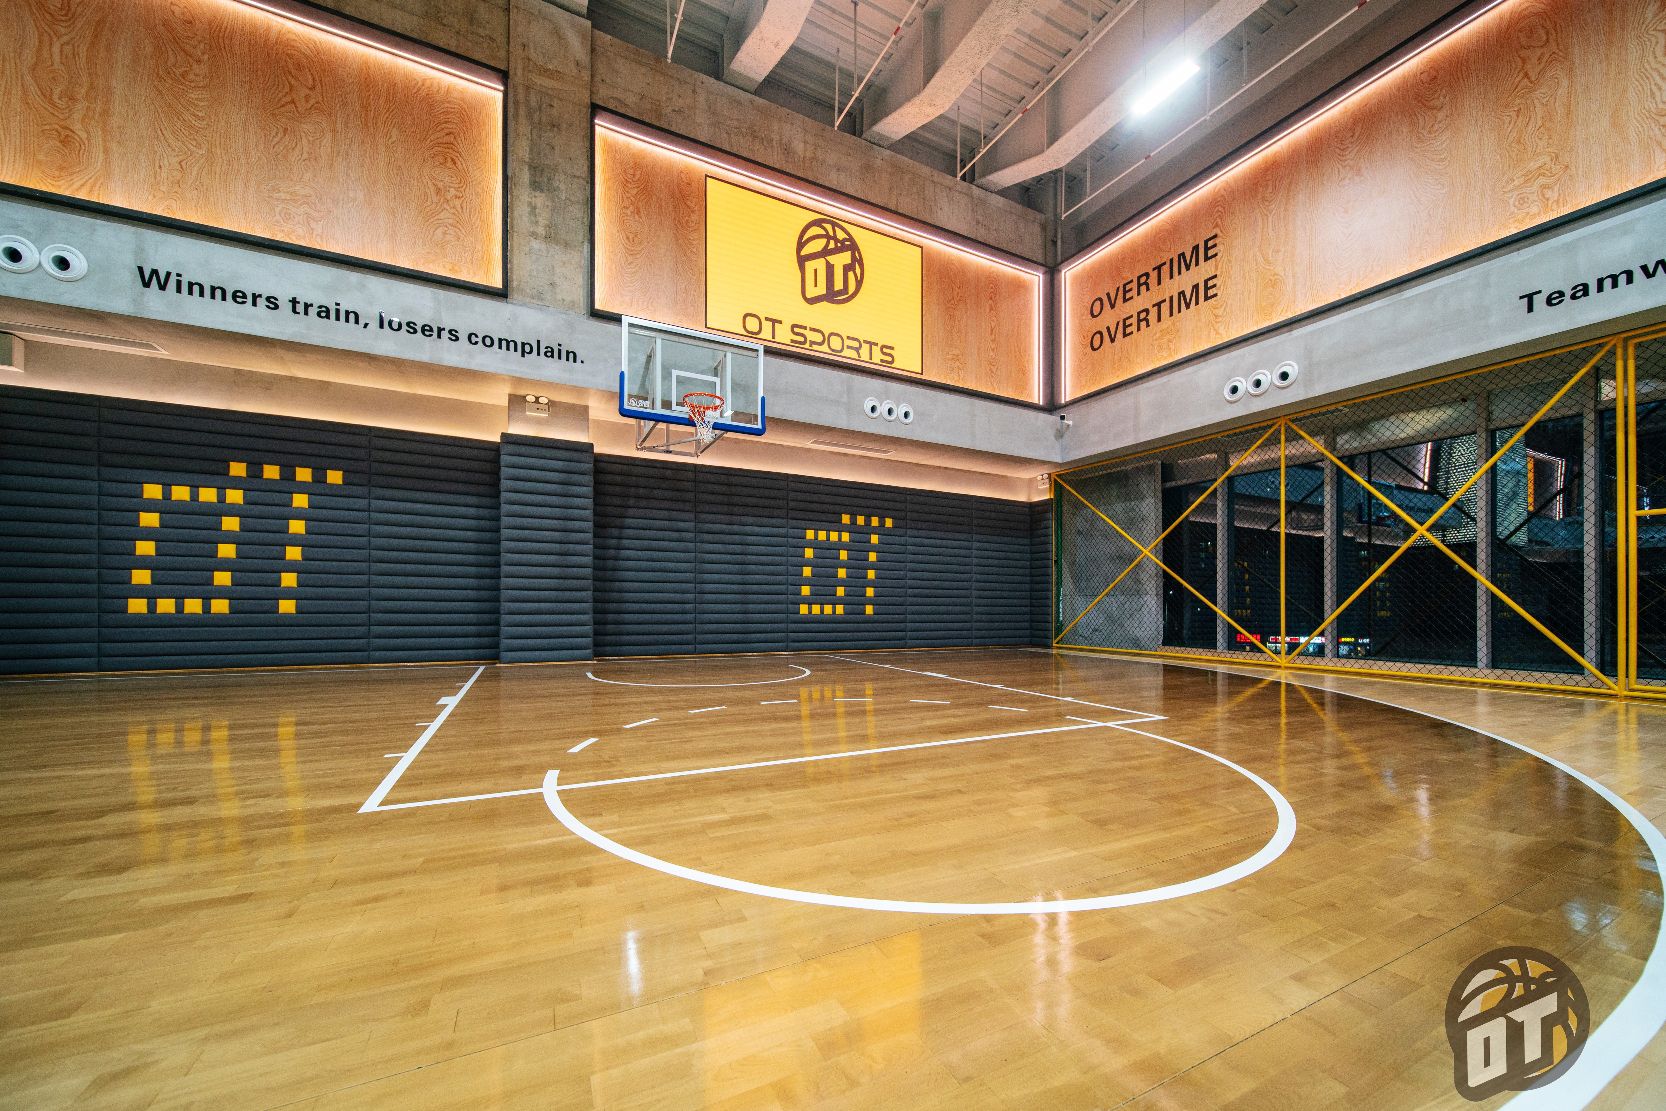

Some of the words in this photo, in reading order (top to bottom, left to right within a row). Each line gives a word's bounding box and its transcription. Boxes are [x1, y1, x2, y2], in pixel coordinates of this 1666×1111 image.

[136, 265, 280, 311] Winners
[288, 296, 371, 330] train,
[378, 310, 460, 343] losers
[467, 332, 586, 365] complain.
[803, 249, 853, 302] OT
[1089, 233, 1218, 319] OVERTIME
[1089, 273, 1218, 352] OVERTIME
[742, 312, 783, 340] OT
[790, 323, 895, 365] SPORTS
